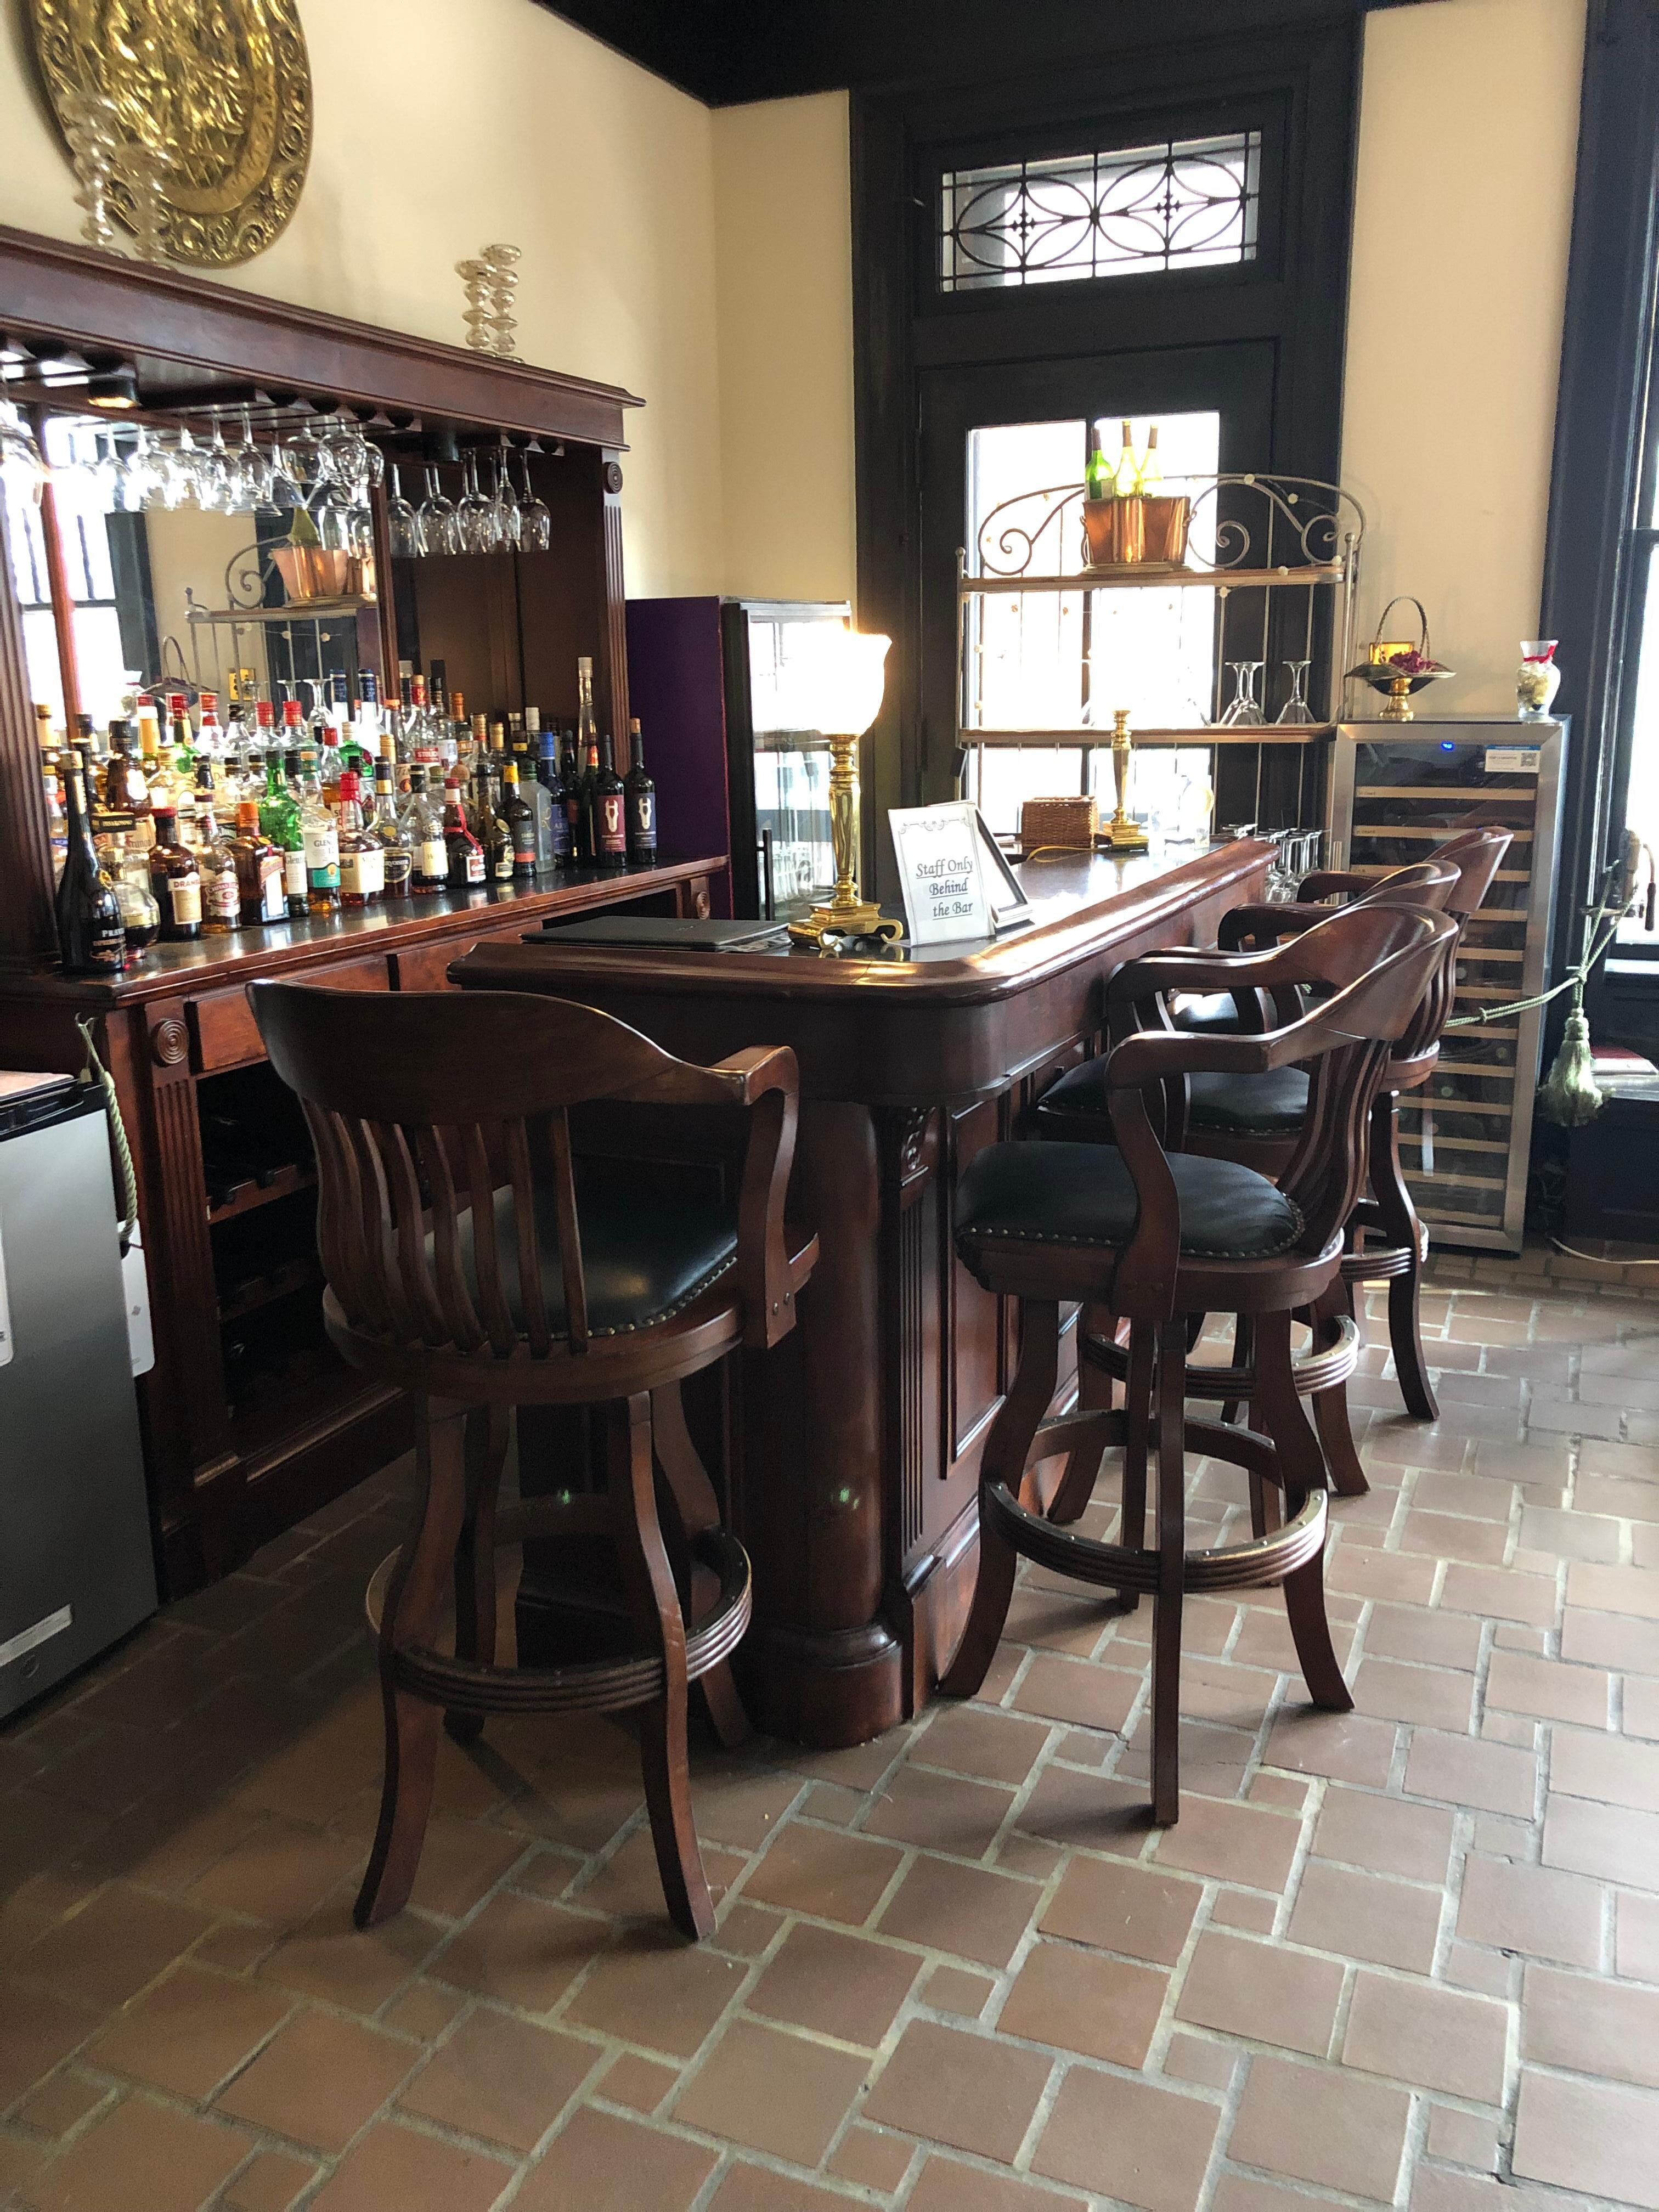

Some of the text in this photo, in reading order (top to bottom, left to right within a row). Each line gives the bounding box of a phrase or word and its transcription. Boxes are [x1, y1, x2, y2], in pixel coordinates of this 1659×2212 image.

[916, 856, 973, 878] Staff Only
[929, 877, 969, 896] Behind
[933, 901, 973, 917] the Bar
